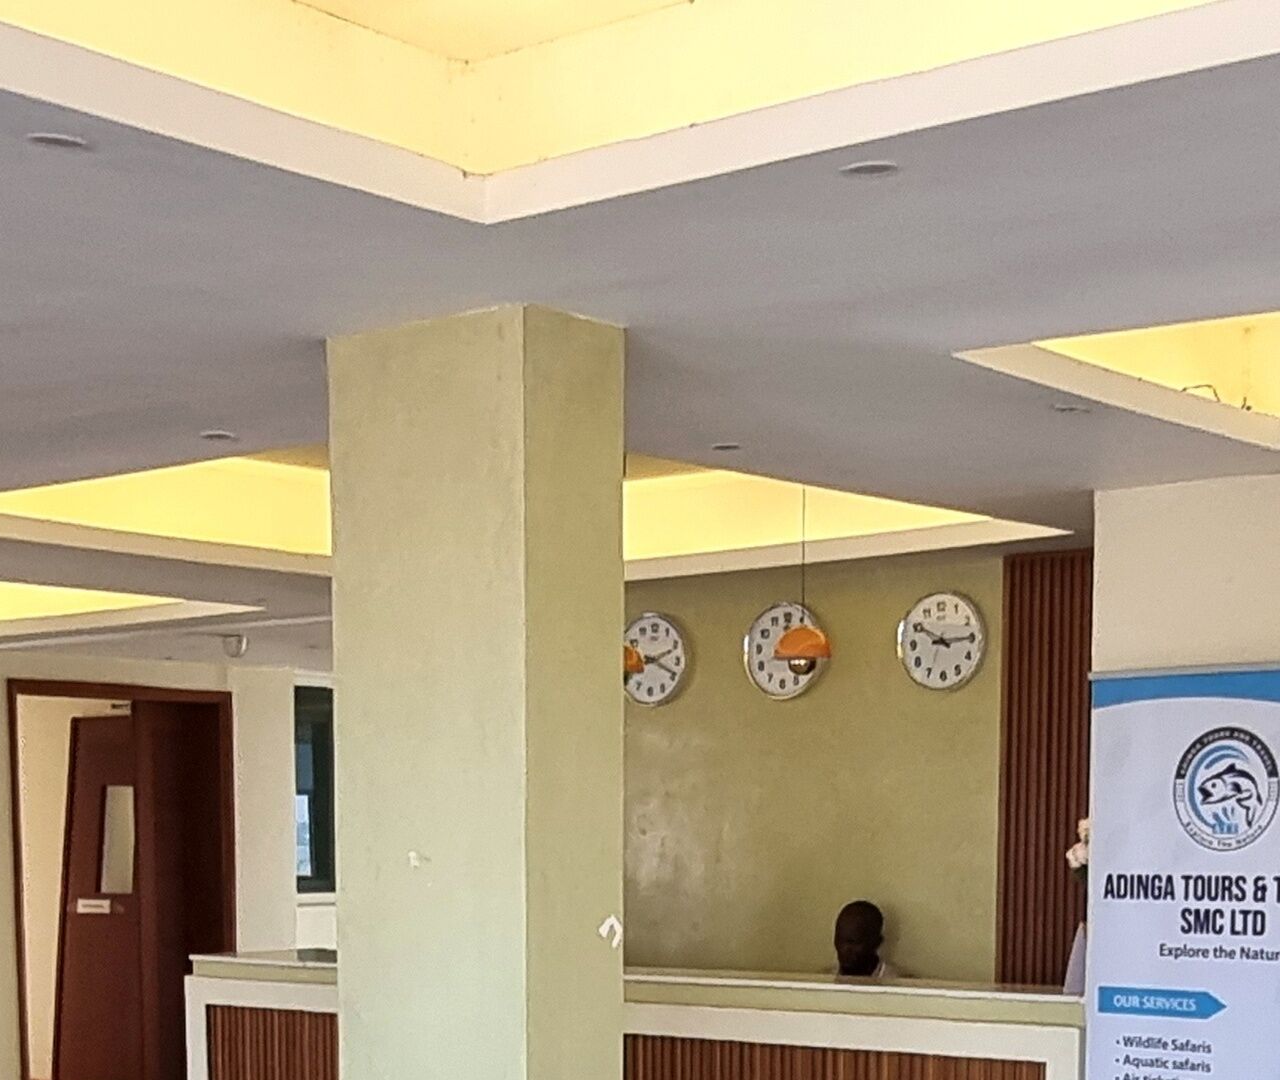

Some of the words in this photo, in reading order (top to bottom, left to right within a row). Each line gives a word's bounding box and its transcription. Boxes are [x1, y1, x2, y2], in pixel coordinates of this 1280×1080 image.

[954, 603, 958, 614] 1
[927, 667, 932, 678] 7
[1104, 873, 1175, 900] ADINGA
[1181, 875, 1246, 902] TOURS
[1253, 878, 1267, 902] &
[1180, 908, 1224, 934] SMC
[1230, 909, 1266, 936] LTD
[1160, 944, 1208, 961] Explore
[1213, 945, 1236, 958] the
[1113, 996, 1140, 1008] OUR
[1143, 997, 1196, 1011] SERVICES
[1122, 1036, 1168, 1050] Wildlife
[1171, 1039, 1211, 1053] Safaris
[1123, 1055, 1168, 1070] Aquatic
[1172, 1058, 1211, 1073] safaris
